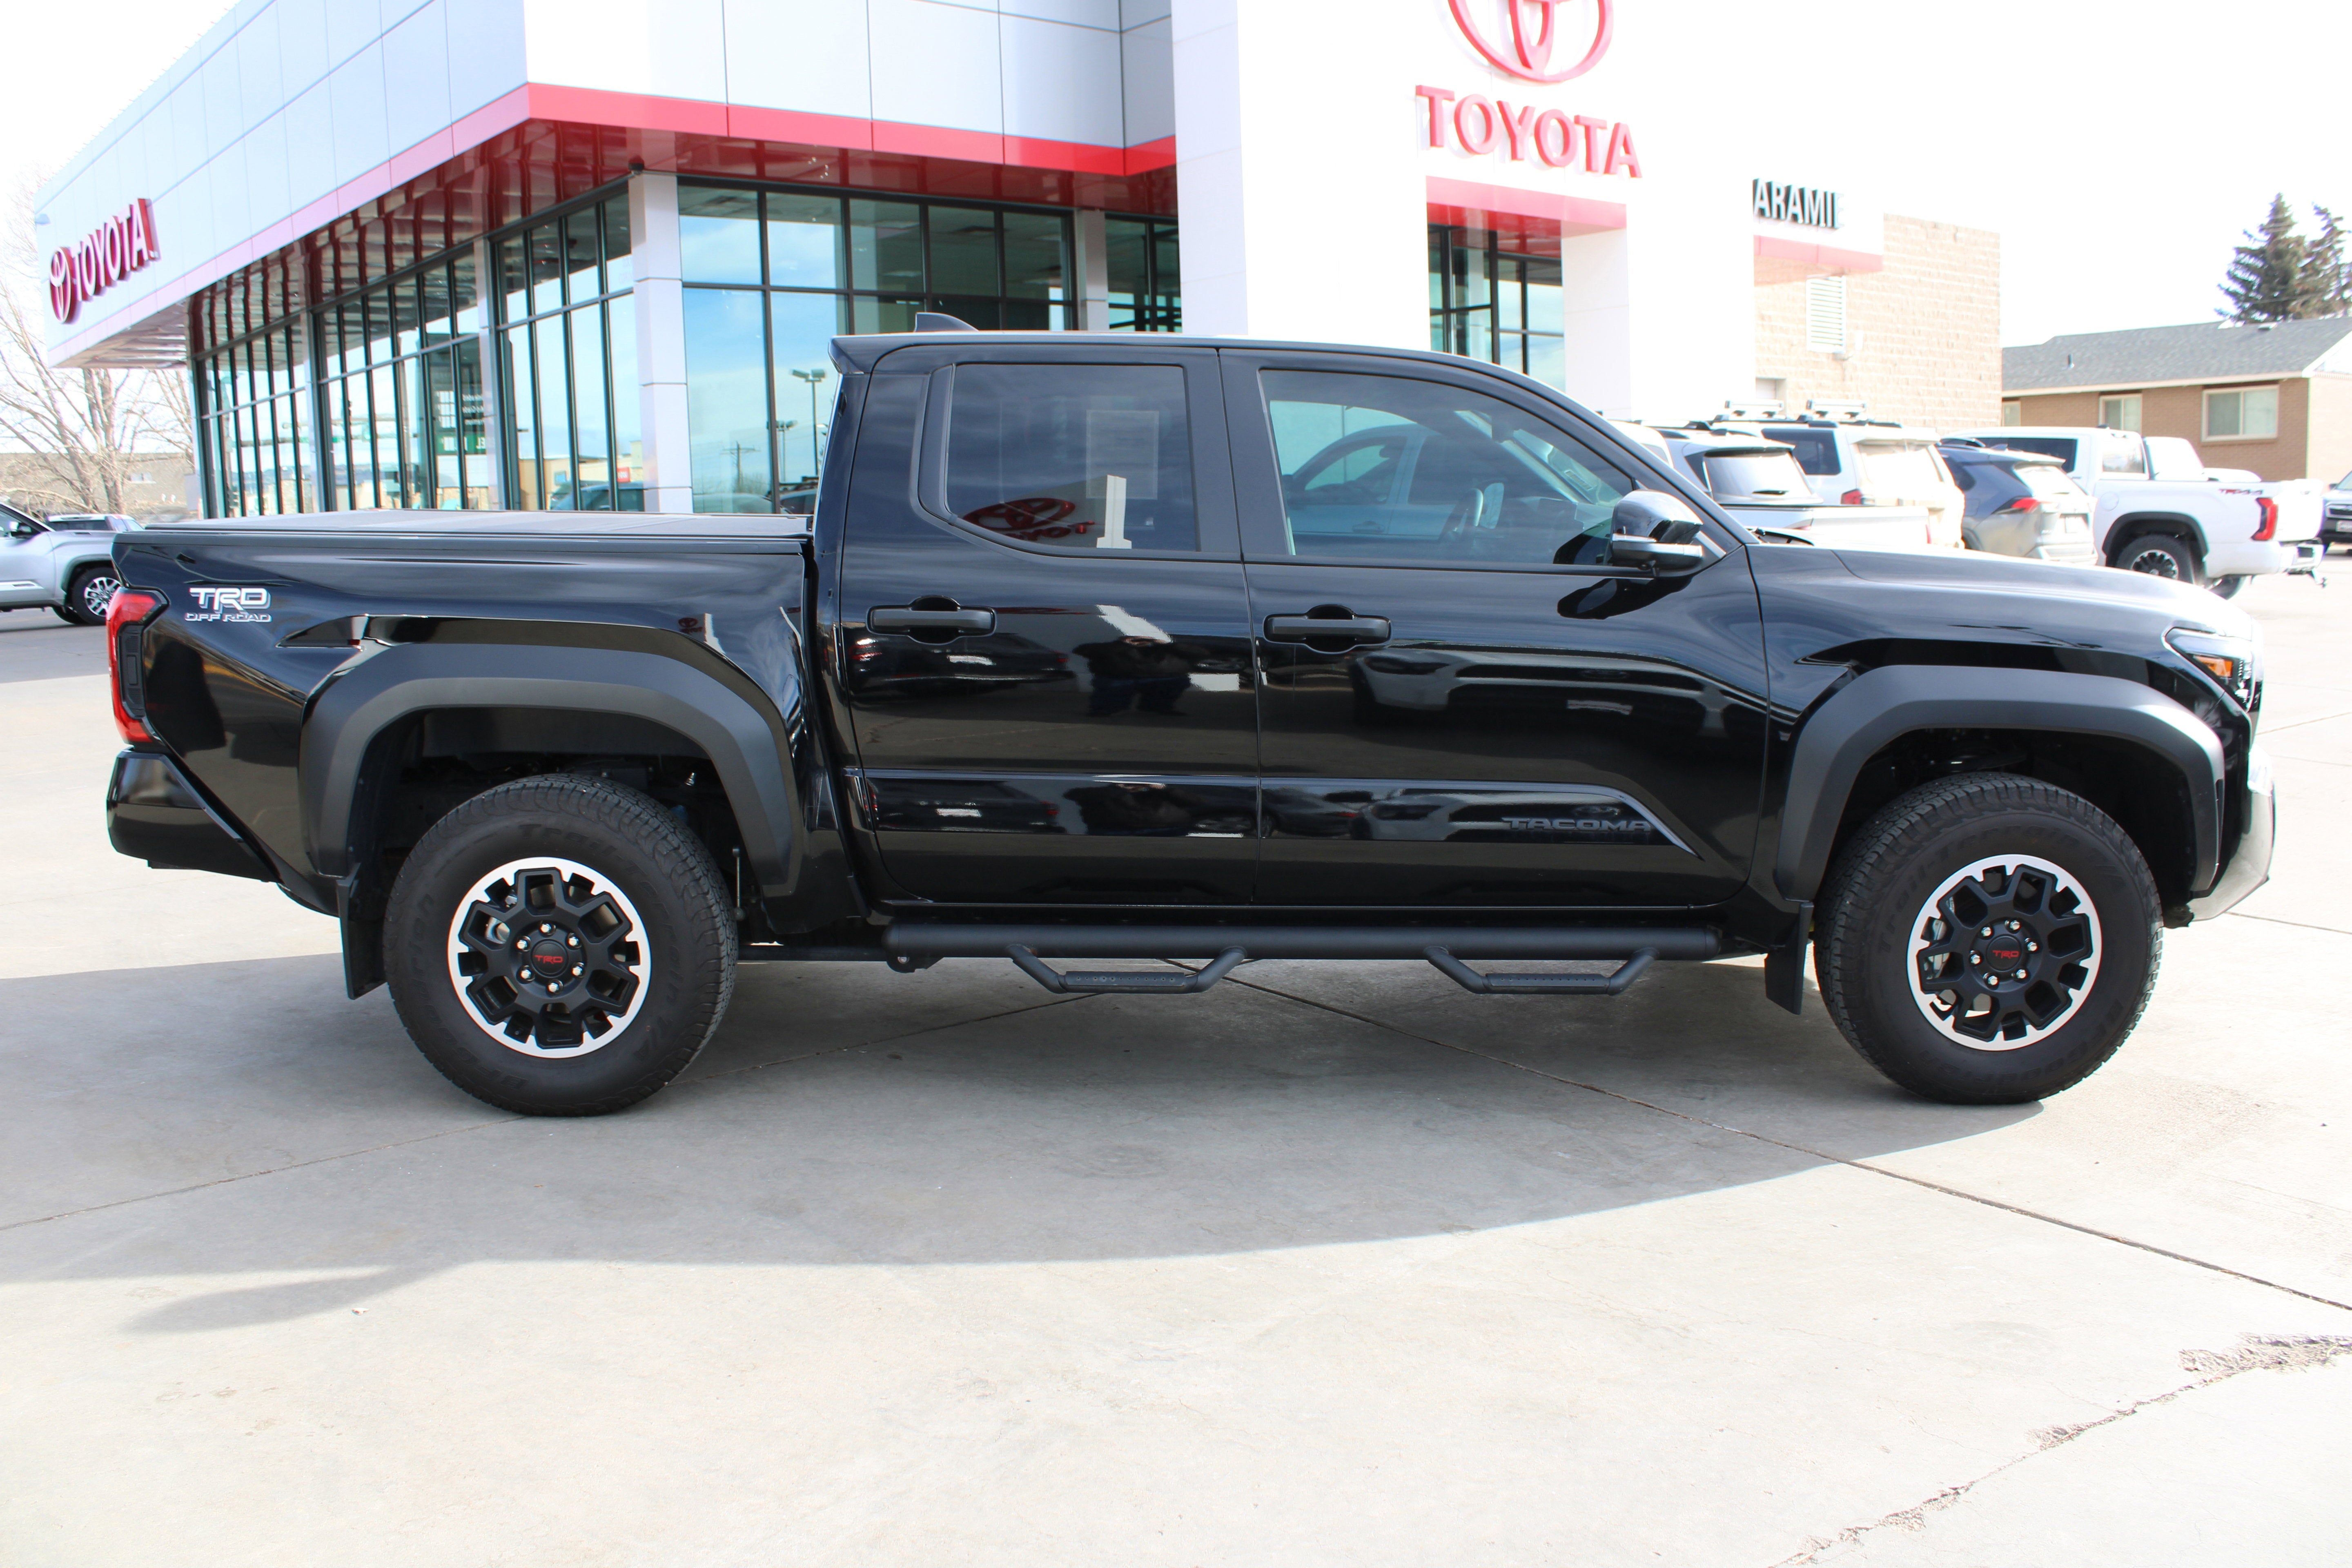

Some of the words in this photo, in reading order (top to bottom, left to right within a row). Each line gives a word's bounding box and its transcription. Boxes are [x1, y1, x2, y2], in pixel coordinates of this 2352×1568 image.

[1416, 85, 1642, 178] TOYOTA
[70, 198, 156, 301] TOYOTA
[189, 587, 271, 614] TRD
[185, 613, 220, 622] OFF
[222, 613, 272, 622] ROAD
[1501, 817, 1651, 832] TACOMA
[535, 955, 564, 964] TRD
[1992, 950, 2020, 959] TRD
